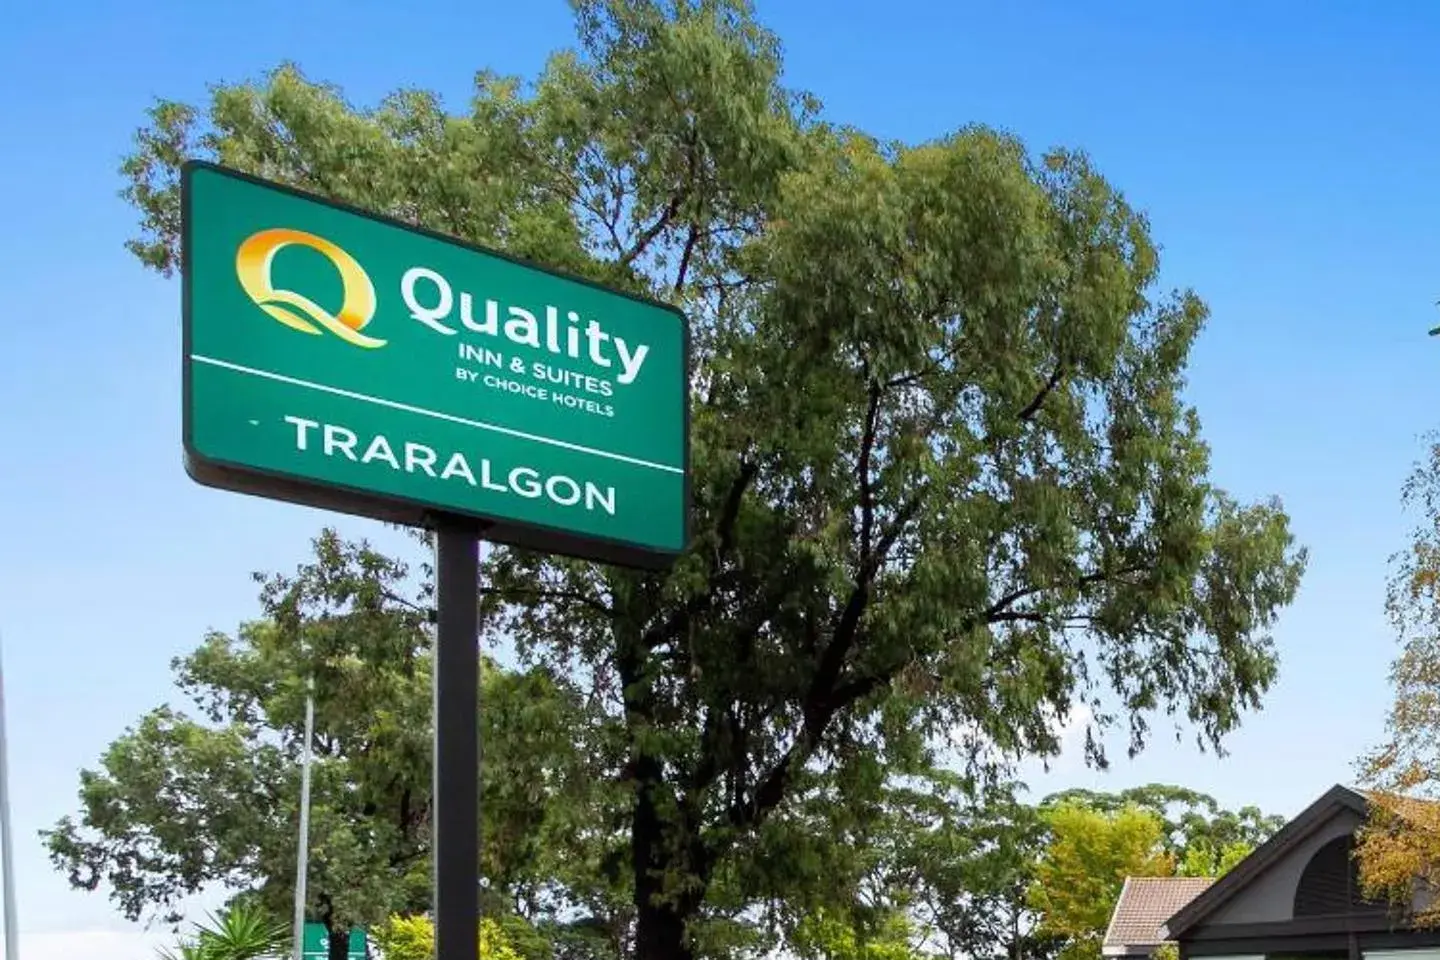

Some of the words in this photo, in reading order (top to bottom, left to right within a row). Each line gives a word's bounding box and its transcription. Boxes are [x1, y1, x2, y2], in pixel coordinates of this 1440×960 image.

[401, 267, 649, 384] Quality
[456, 367, 479, 382] BY
[484, 376, 548, 400] CHOICE
[553, 393, 614, 417] HOTELS
[458, 343, 502, 369] INN
[510, 357, 525, 374] &
[533, 363, 614, 397] SUITES
[285, 416, 617, 515] TRARALGON
